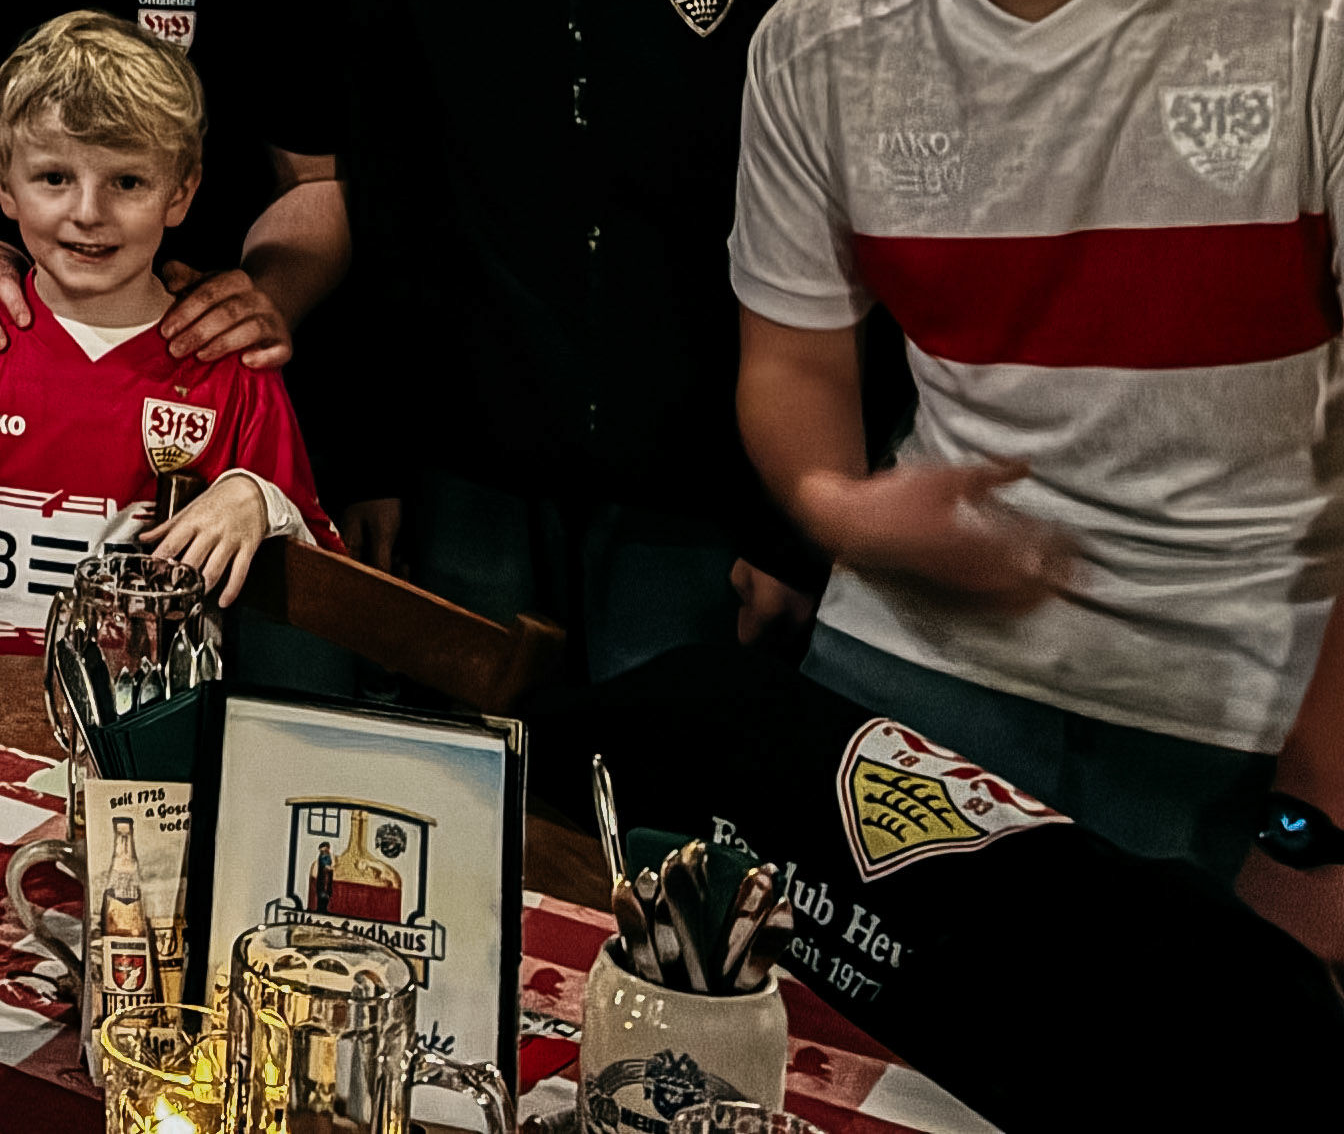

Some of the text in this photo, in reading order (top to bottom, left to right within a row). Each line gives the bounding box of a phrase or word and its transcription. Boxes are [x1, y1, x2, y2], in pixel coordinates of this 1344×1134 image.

[890, 748, 921, 769] 18
[962, 795, 994, 816] 93
[785, 935, 822, 973] eit
